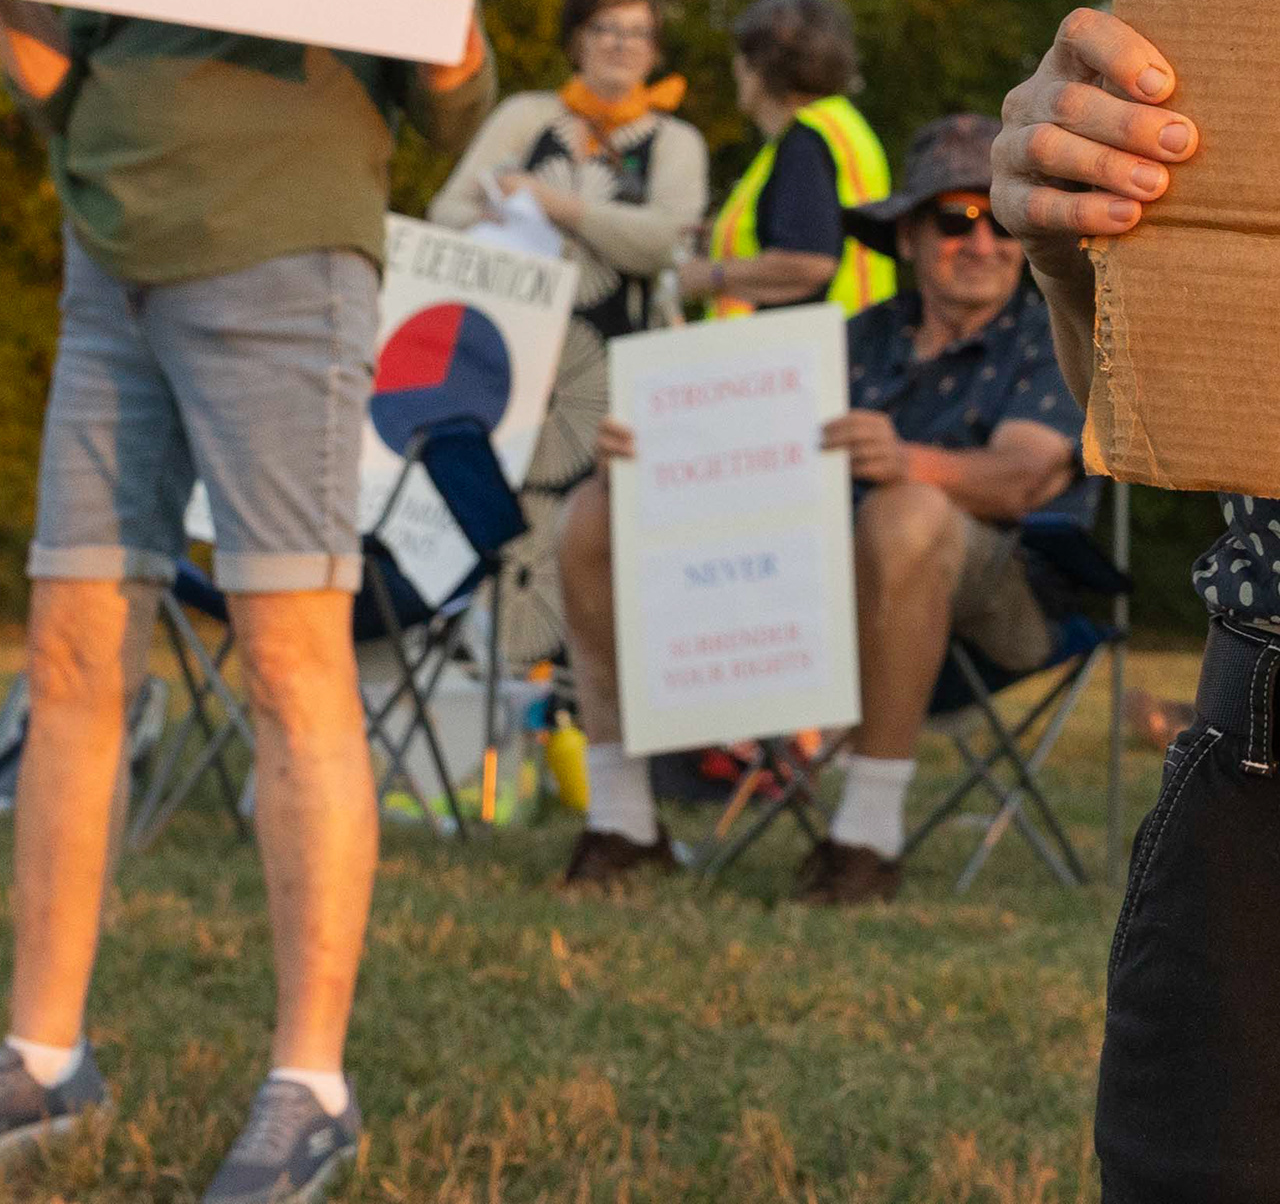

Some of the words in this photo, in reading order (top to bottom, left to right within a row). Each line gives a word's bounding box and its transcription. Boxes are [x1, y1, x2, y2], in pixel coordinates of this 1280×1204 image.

[648, 367, 802, 414] STRONGER
[654, 441, 805, 488] TOGETHER
[683, 552, 779, 587] NEVER
